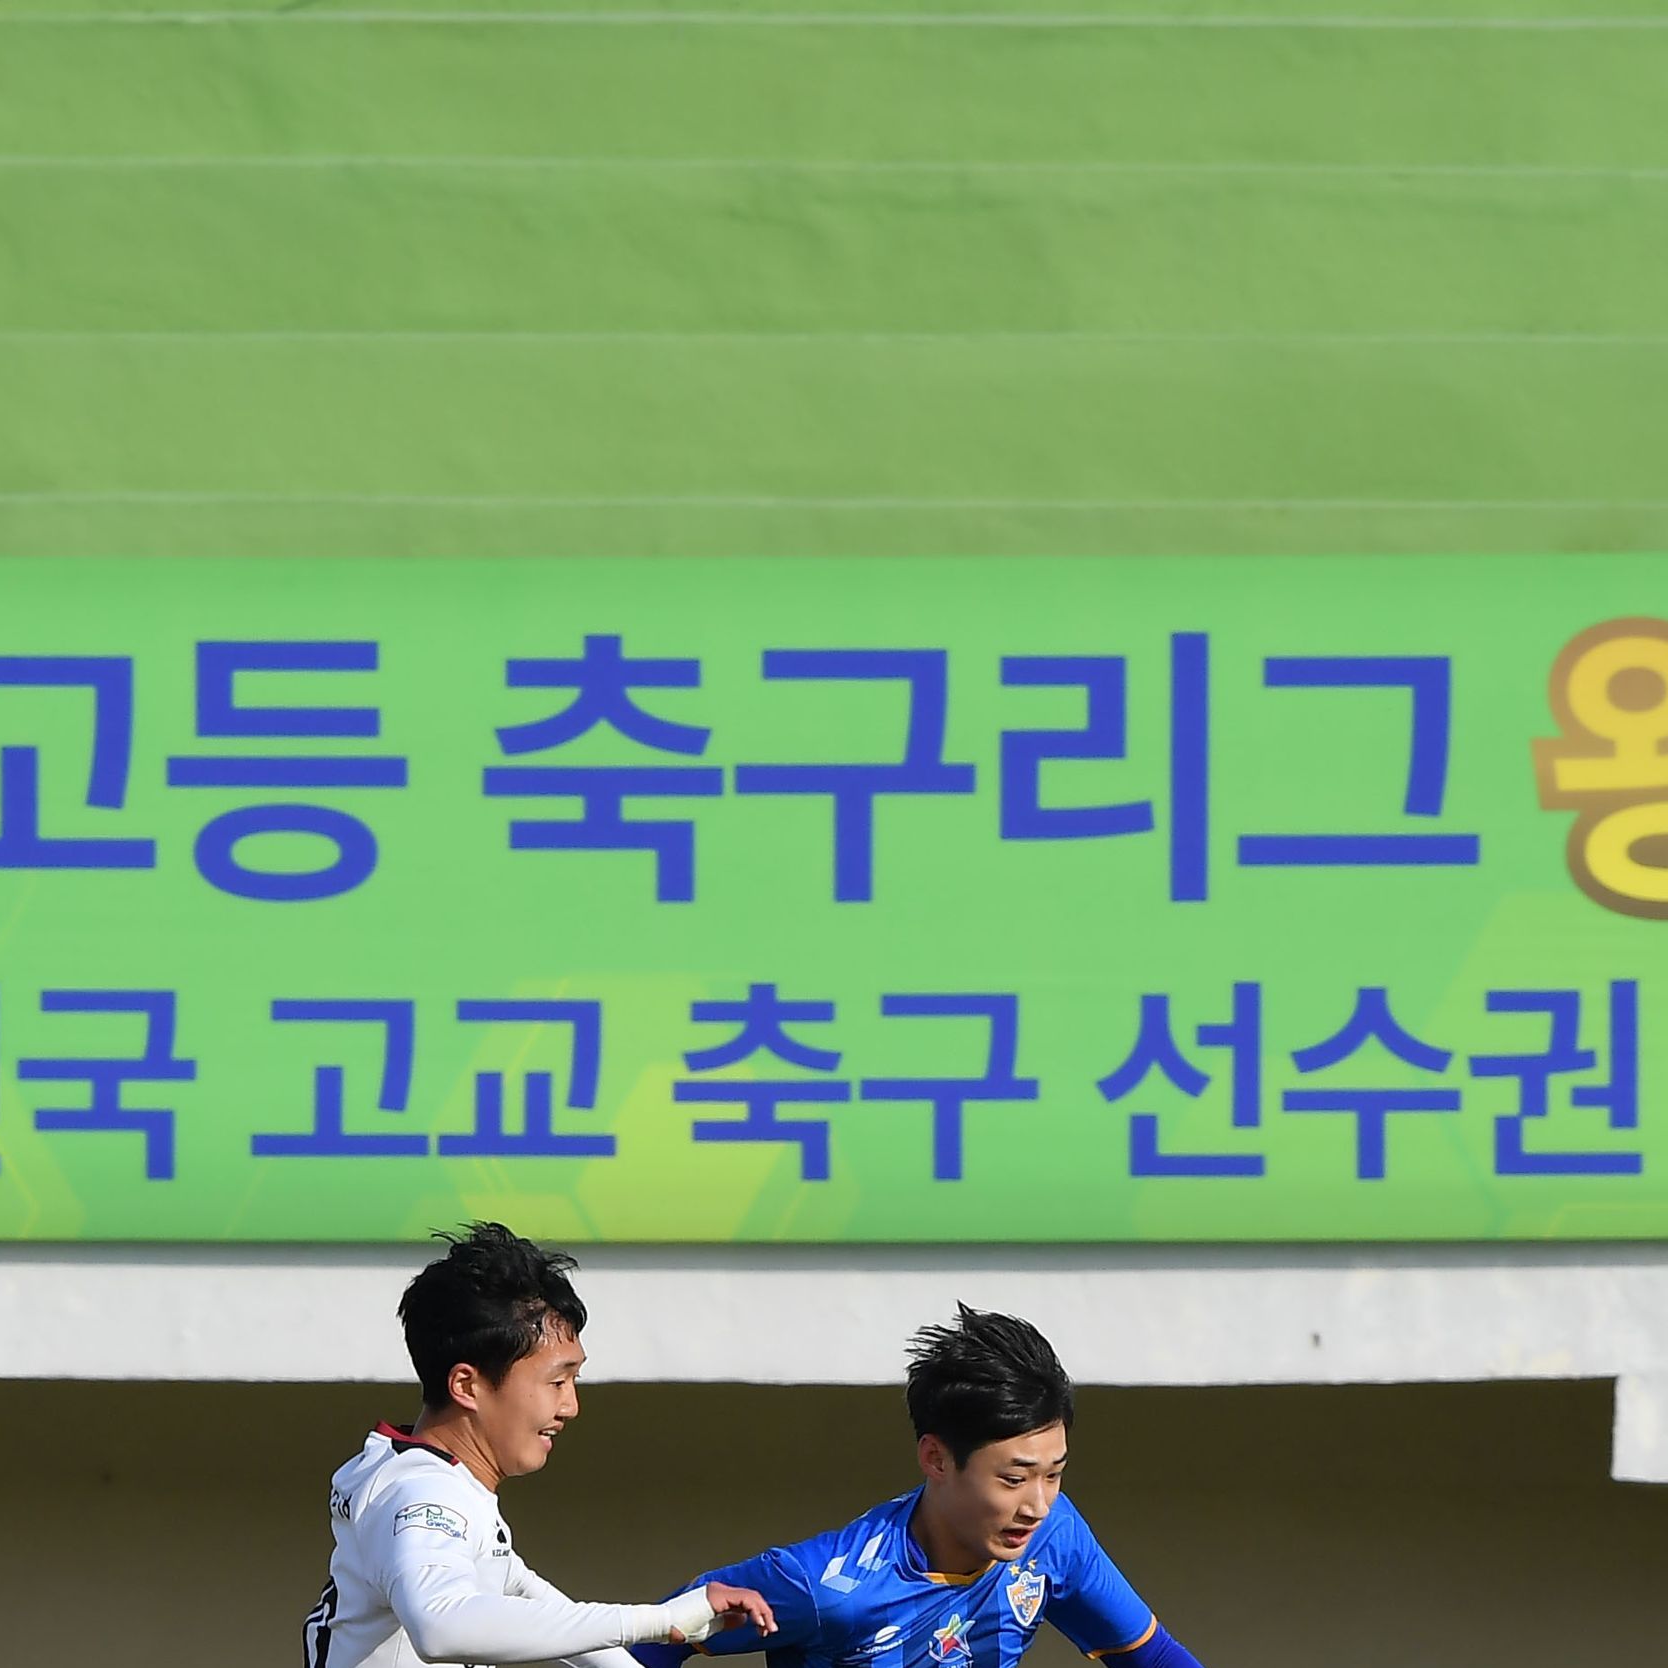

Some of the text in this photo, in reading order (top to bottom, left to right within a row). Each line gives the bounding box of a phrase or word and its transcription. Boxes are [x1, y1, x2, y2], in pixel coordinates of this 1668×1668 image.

[483, 632, 1479, 902] 축구리그
[252, 999, 616, 1156] 고교
[673, 984, 1039, 1180] 축구
[1097, 981, 1642, 1180] 선수권
